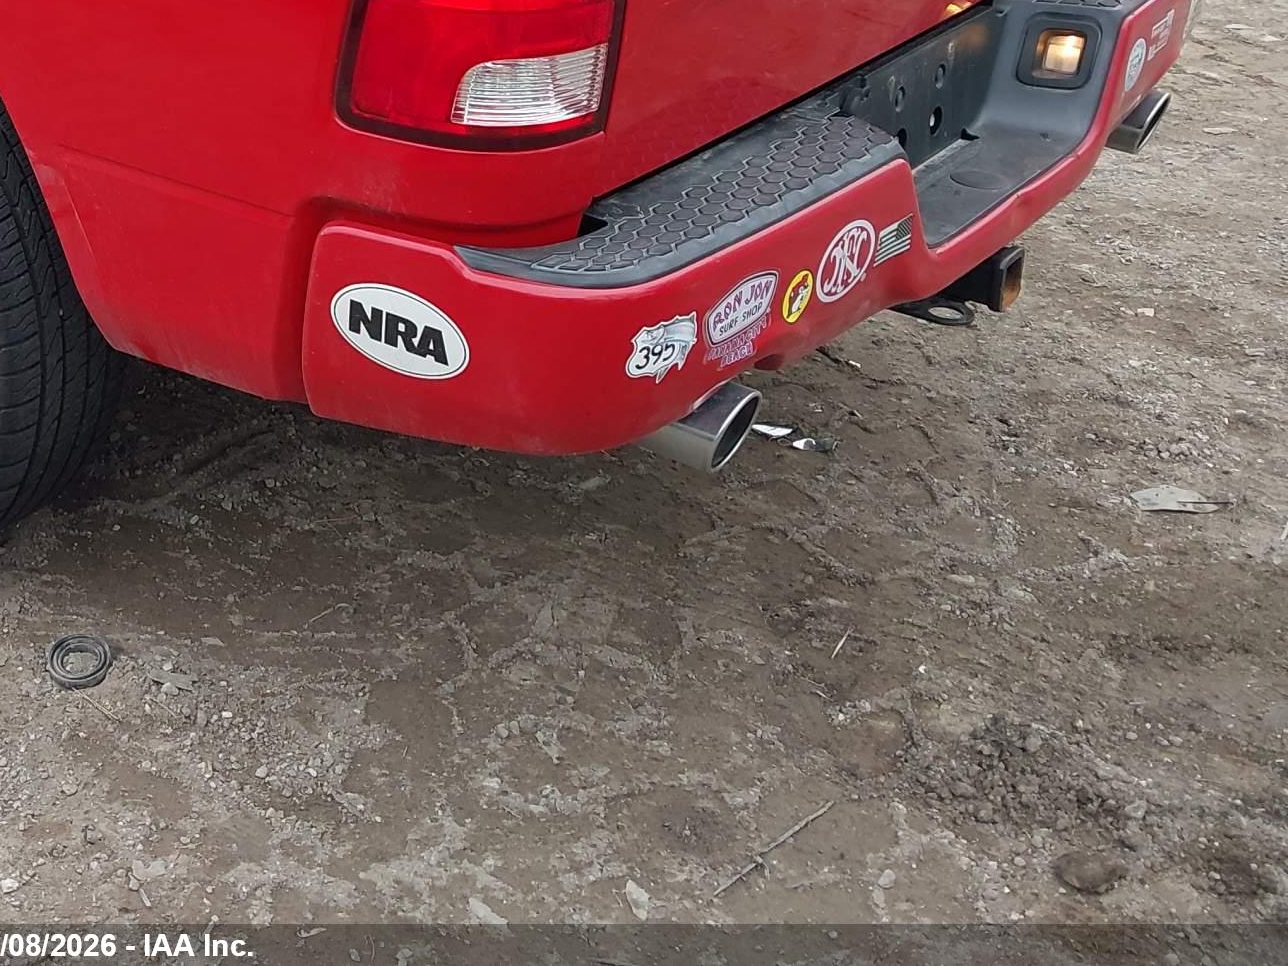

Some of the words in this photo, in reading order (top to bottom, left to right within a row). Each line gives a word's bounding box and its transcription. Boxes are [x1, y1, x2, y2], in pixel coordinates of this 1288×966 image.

[713, 290, 743, 332] RON
[744, 279, 773, 305] JON
[719, 316, 740, 337] SURF
[742, 301, 763, 322] SHOP
[348, 298, 450, 367] NRA
[635, 343, 676, 370] 395
